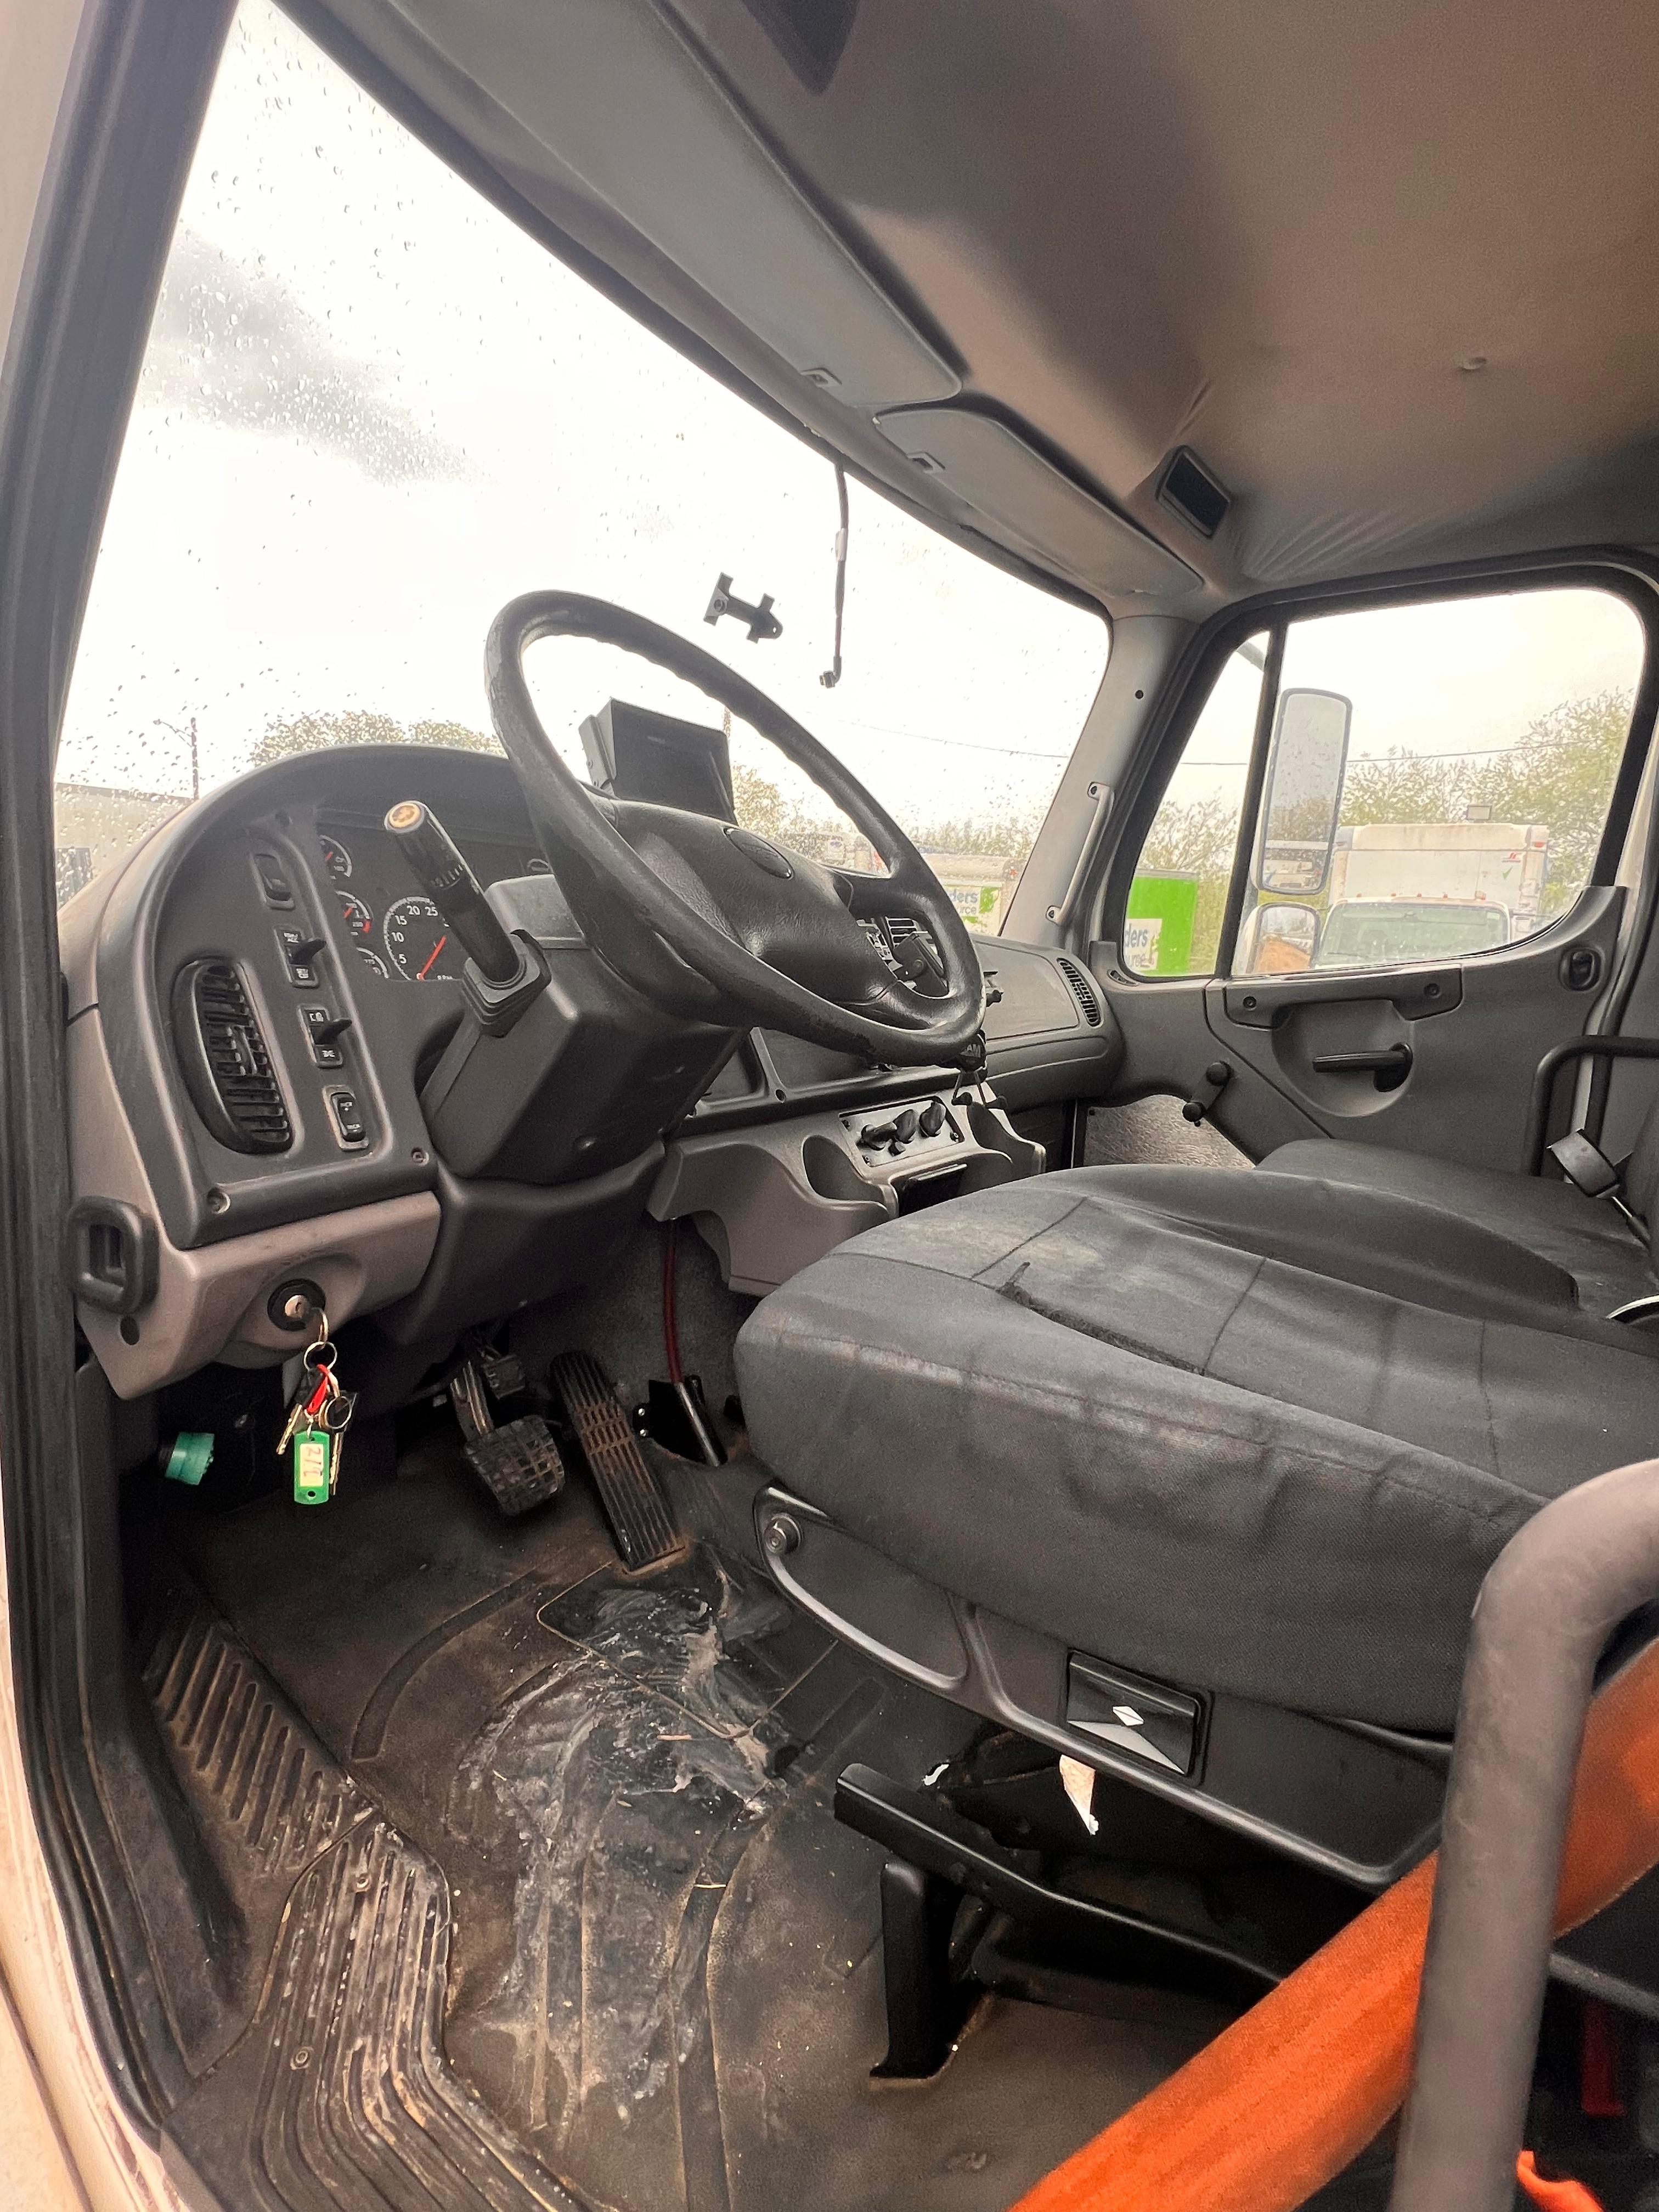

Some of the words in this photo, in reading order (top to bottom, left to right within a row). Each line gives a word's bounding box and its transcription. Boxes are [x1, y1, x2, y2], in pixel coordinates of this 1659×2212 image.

[407, 905, 421, 916] 20
[425, 906, 438, 916] 25
[395, 915, 407, 925] 15
[392, 932, 404, 942] 10
[399, 953, 407, 964] 5
